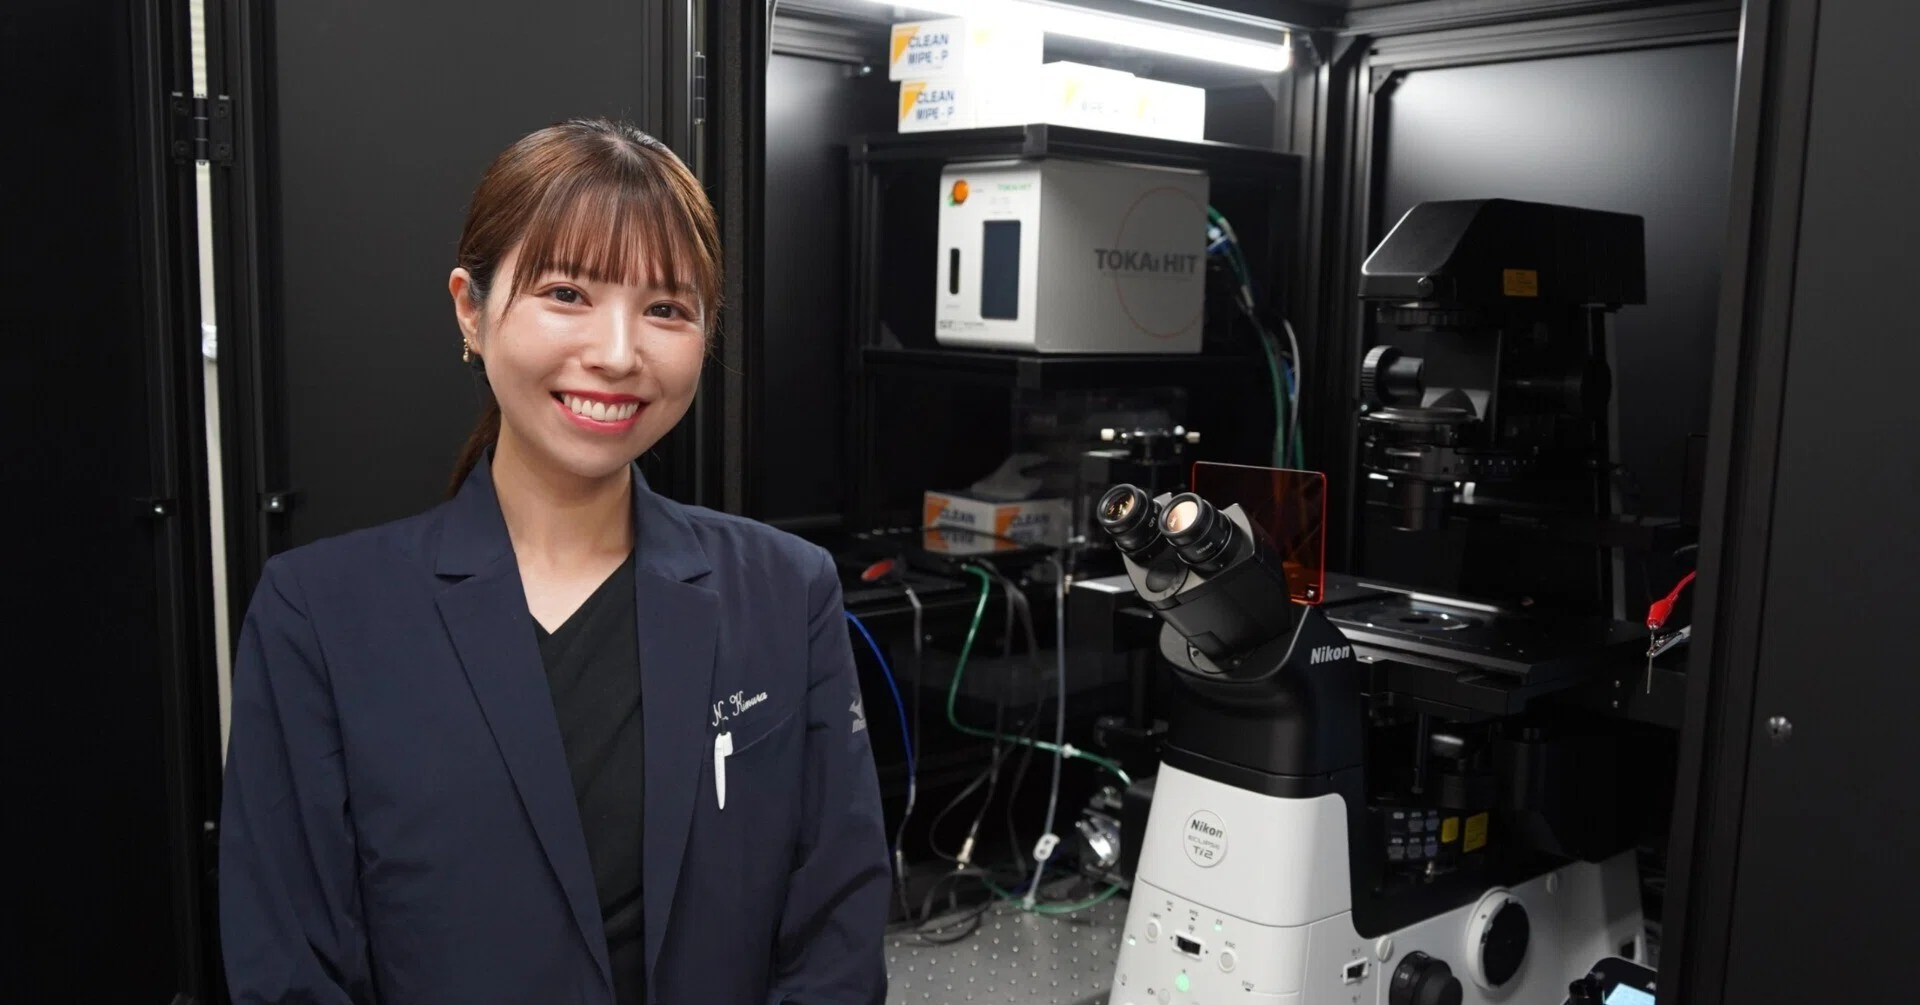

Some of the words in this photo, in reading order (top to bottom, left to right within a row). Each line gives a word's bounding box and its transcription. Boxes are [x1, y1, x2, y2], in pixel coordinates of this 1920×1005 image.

[908, 33, 948, 48] CLEAN
[908, 50, 932, 64] WIPE
[916, 89, 954, 104] CLEAN
[916, 106, 938, 120] WIPE
[1162, 251, 1199, 275] HIT
[1310, 645, 1350, 665] Nikon
[729, 690, 768, 717] Kimura
[1190, 818, 1224, 839] Nikon
